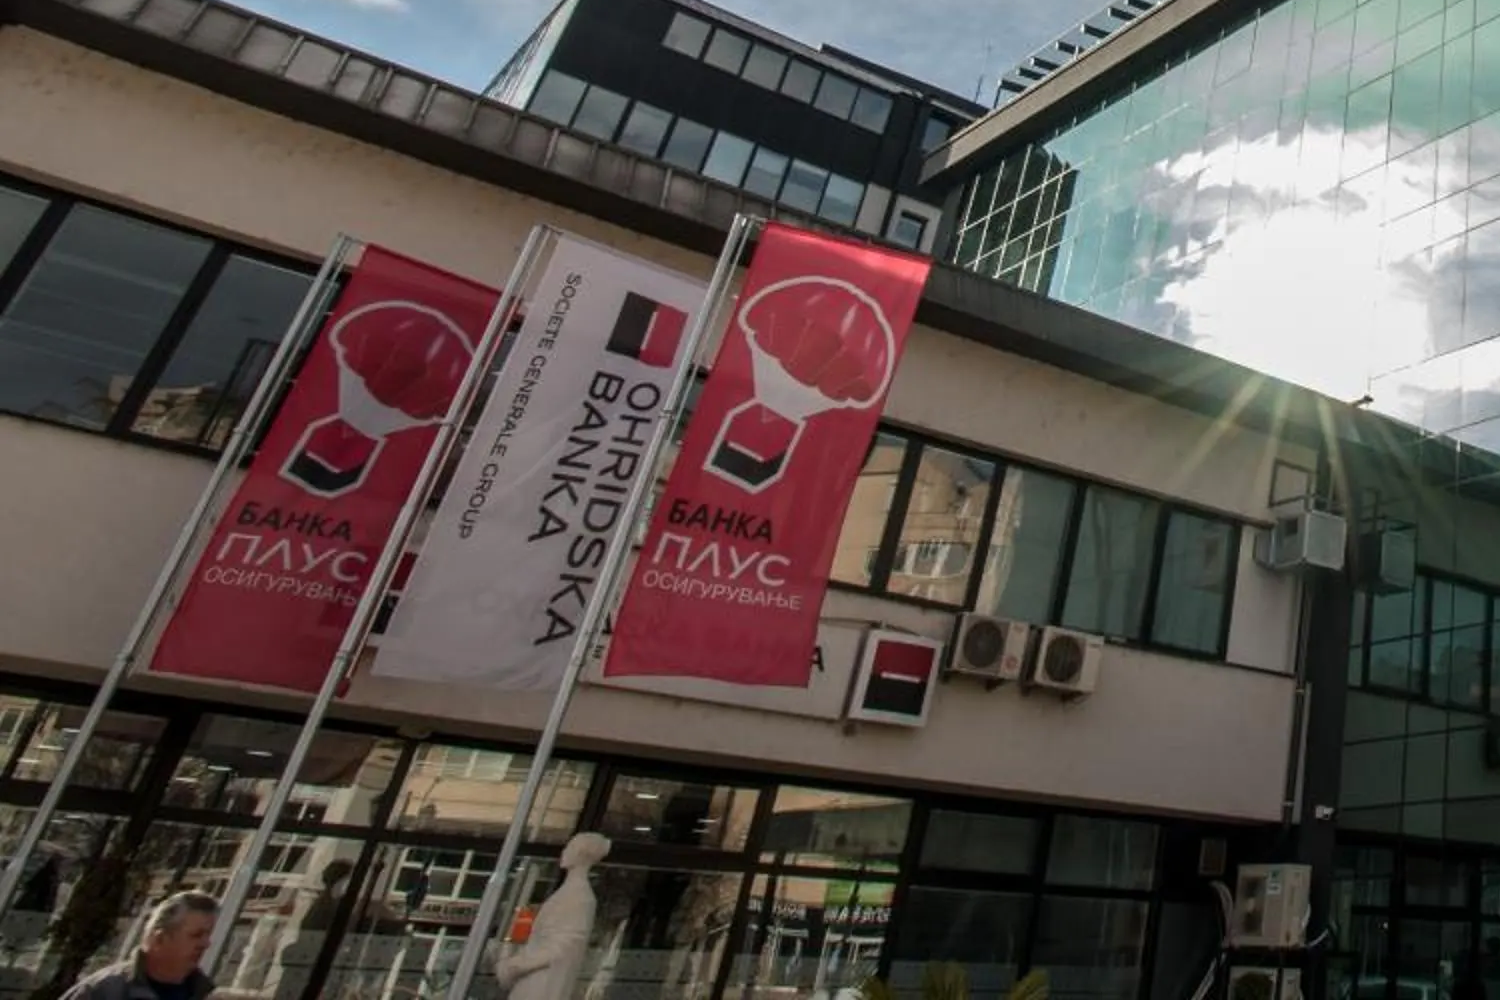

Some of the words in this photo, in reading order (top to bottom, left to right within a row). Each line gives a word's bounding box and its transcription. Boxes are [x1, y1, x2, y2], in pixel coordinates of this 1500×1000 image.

[538, 271, 582, 350] SOCIETE
[489, 355, 547, 457] GENERALE
[527, 370, 625, 542] BANKA
[236, 501, 352, 542] БАНКА
[459, 463, 499, 540] GROUP
[534, 382, 661, 646] OHRIDSKA
[668, 499, 773, 544] БАНКА
[215, 532, 368, 583] ПЛУС
[652, 532, 792, 587] ПЛУС
[204, 566, 357, 607] ОСИГУРУВАЊ
[642, 569, 802, 611] ОСИГУРУВАЊЕ
